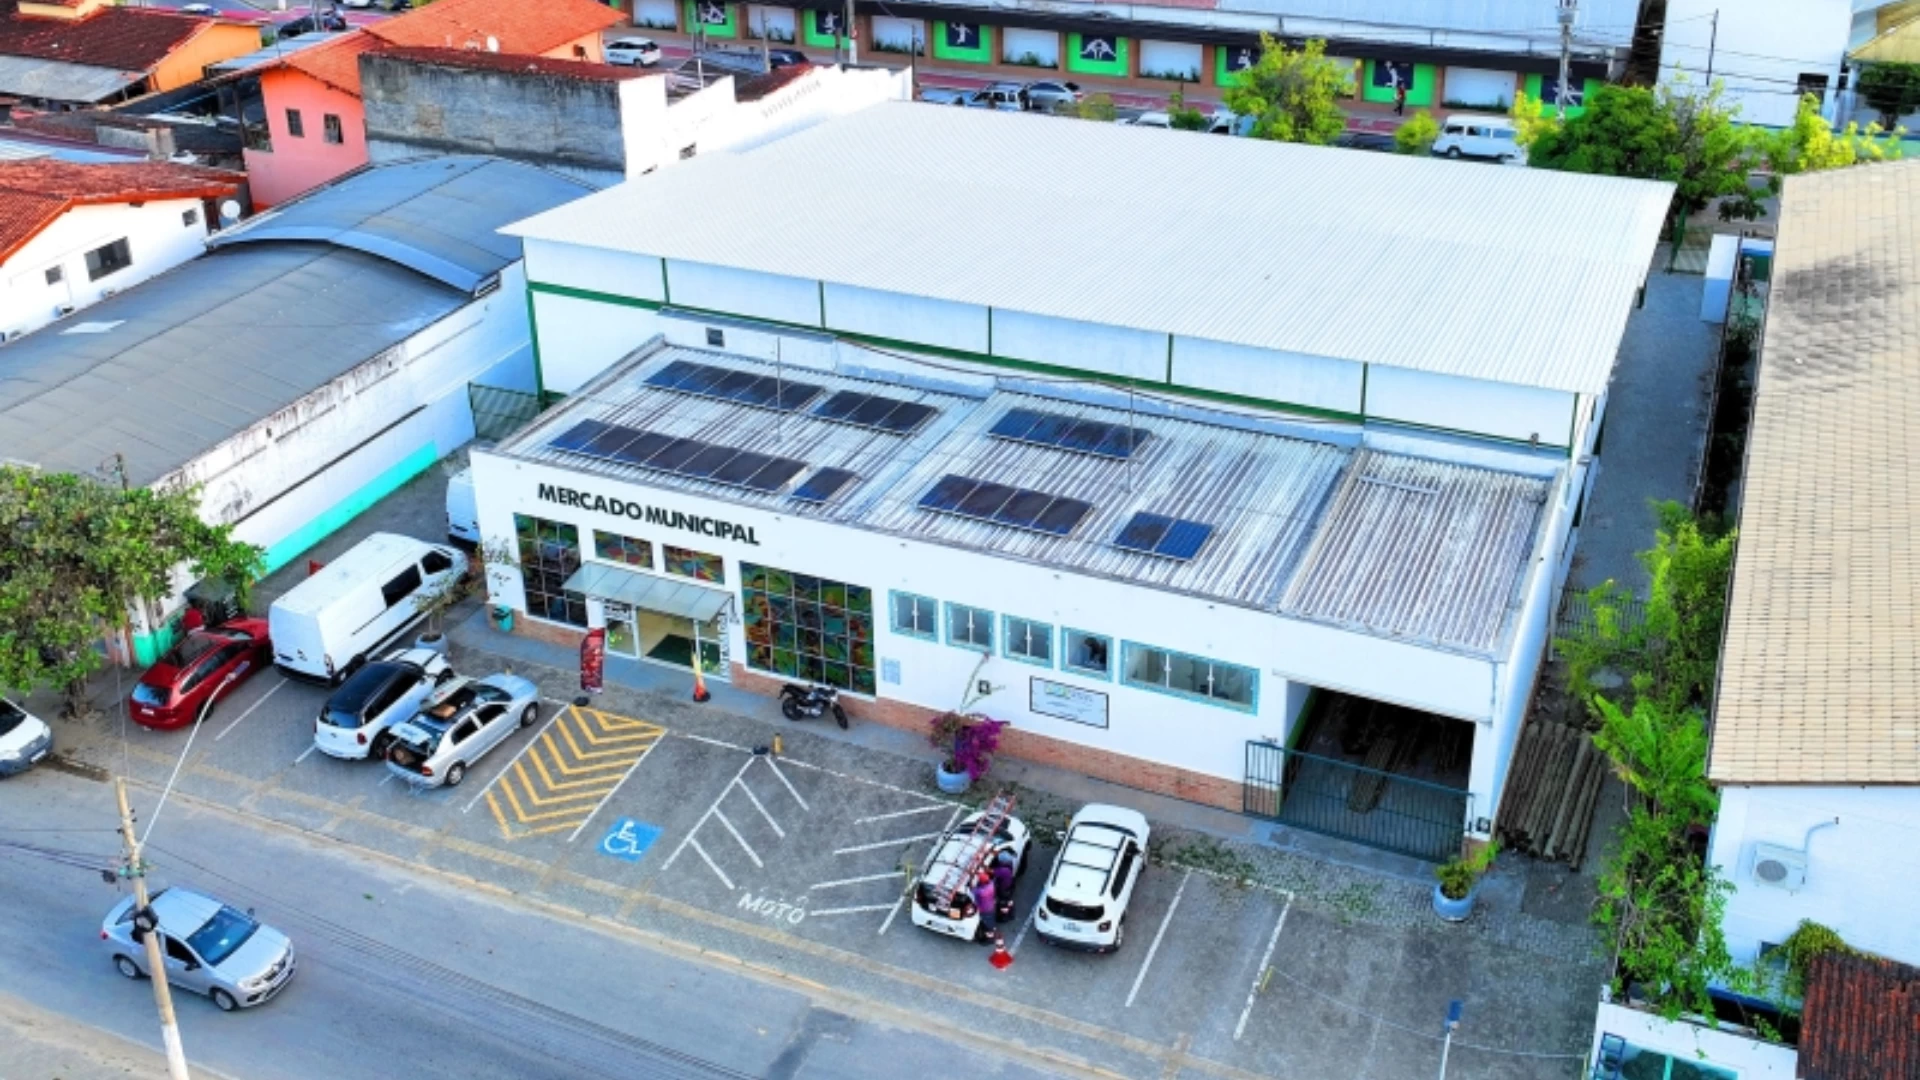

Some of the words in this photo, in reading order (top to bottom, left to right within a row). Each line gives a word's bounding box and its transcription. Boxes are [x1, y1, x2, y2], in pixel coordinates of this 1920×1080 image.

[538, 482, 643, 520] MERCADO
[645, 505, 760, 546] MUNICIPAL
[737, 892, 805, 924] MOTO
